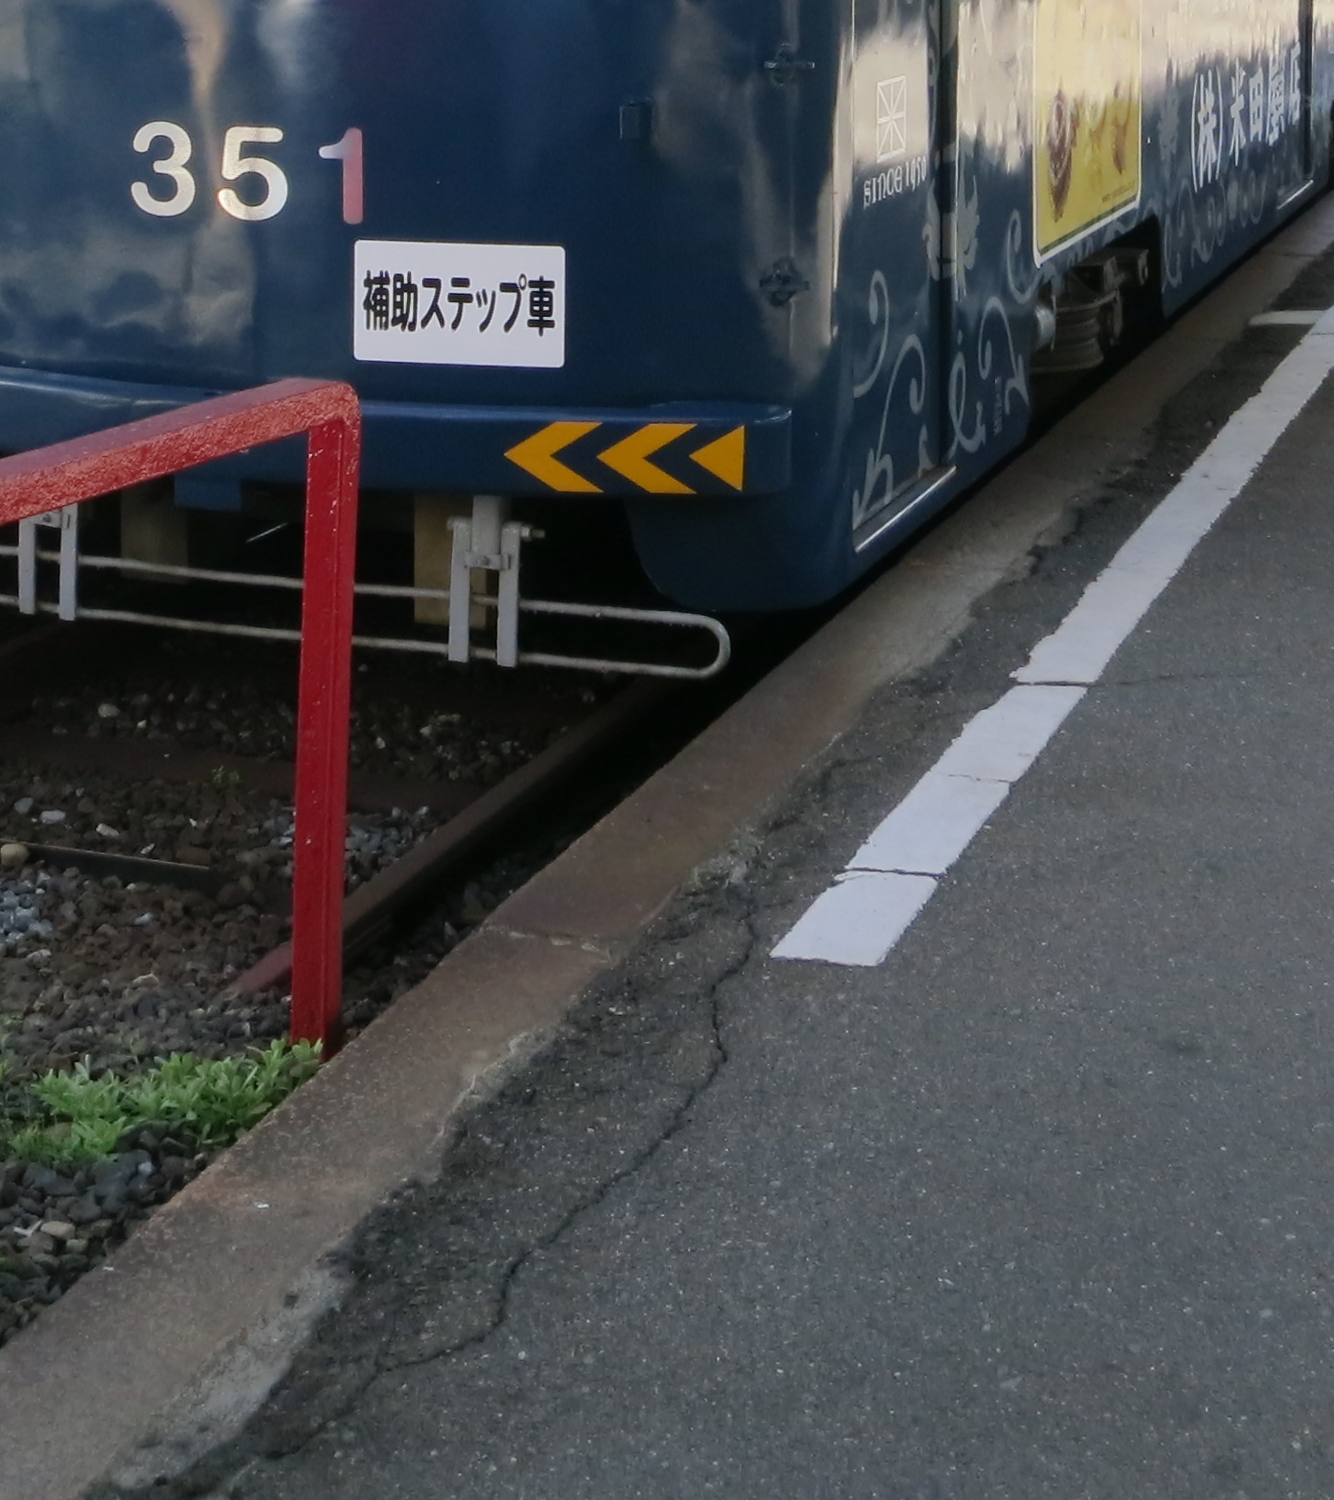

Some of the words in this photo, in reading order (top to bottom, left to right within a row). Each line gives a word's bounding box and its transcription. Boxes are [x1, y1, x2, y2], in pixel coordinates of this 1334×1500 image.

[130, 121, 363, 225] 351
[363, 270, 556, 337] 補助ステップ車
